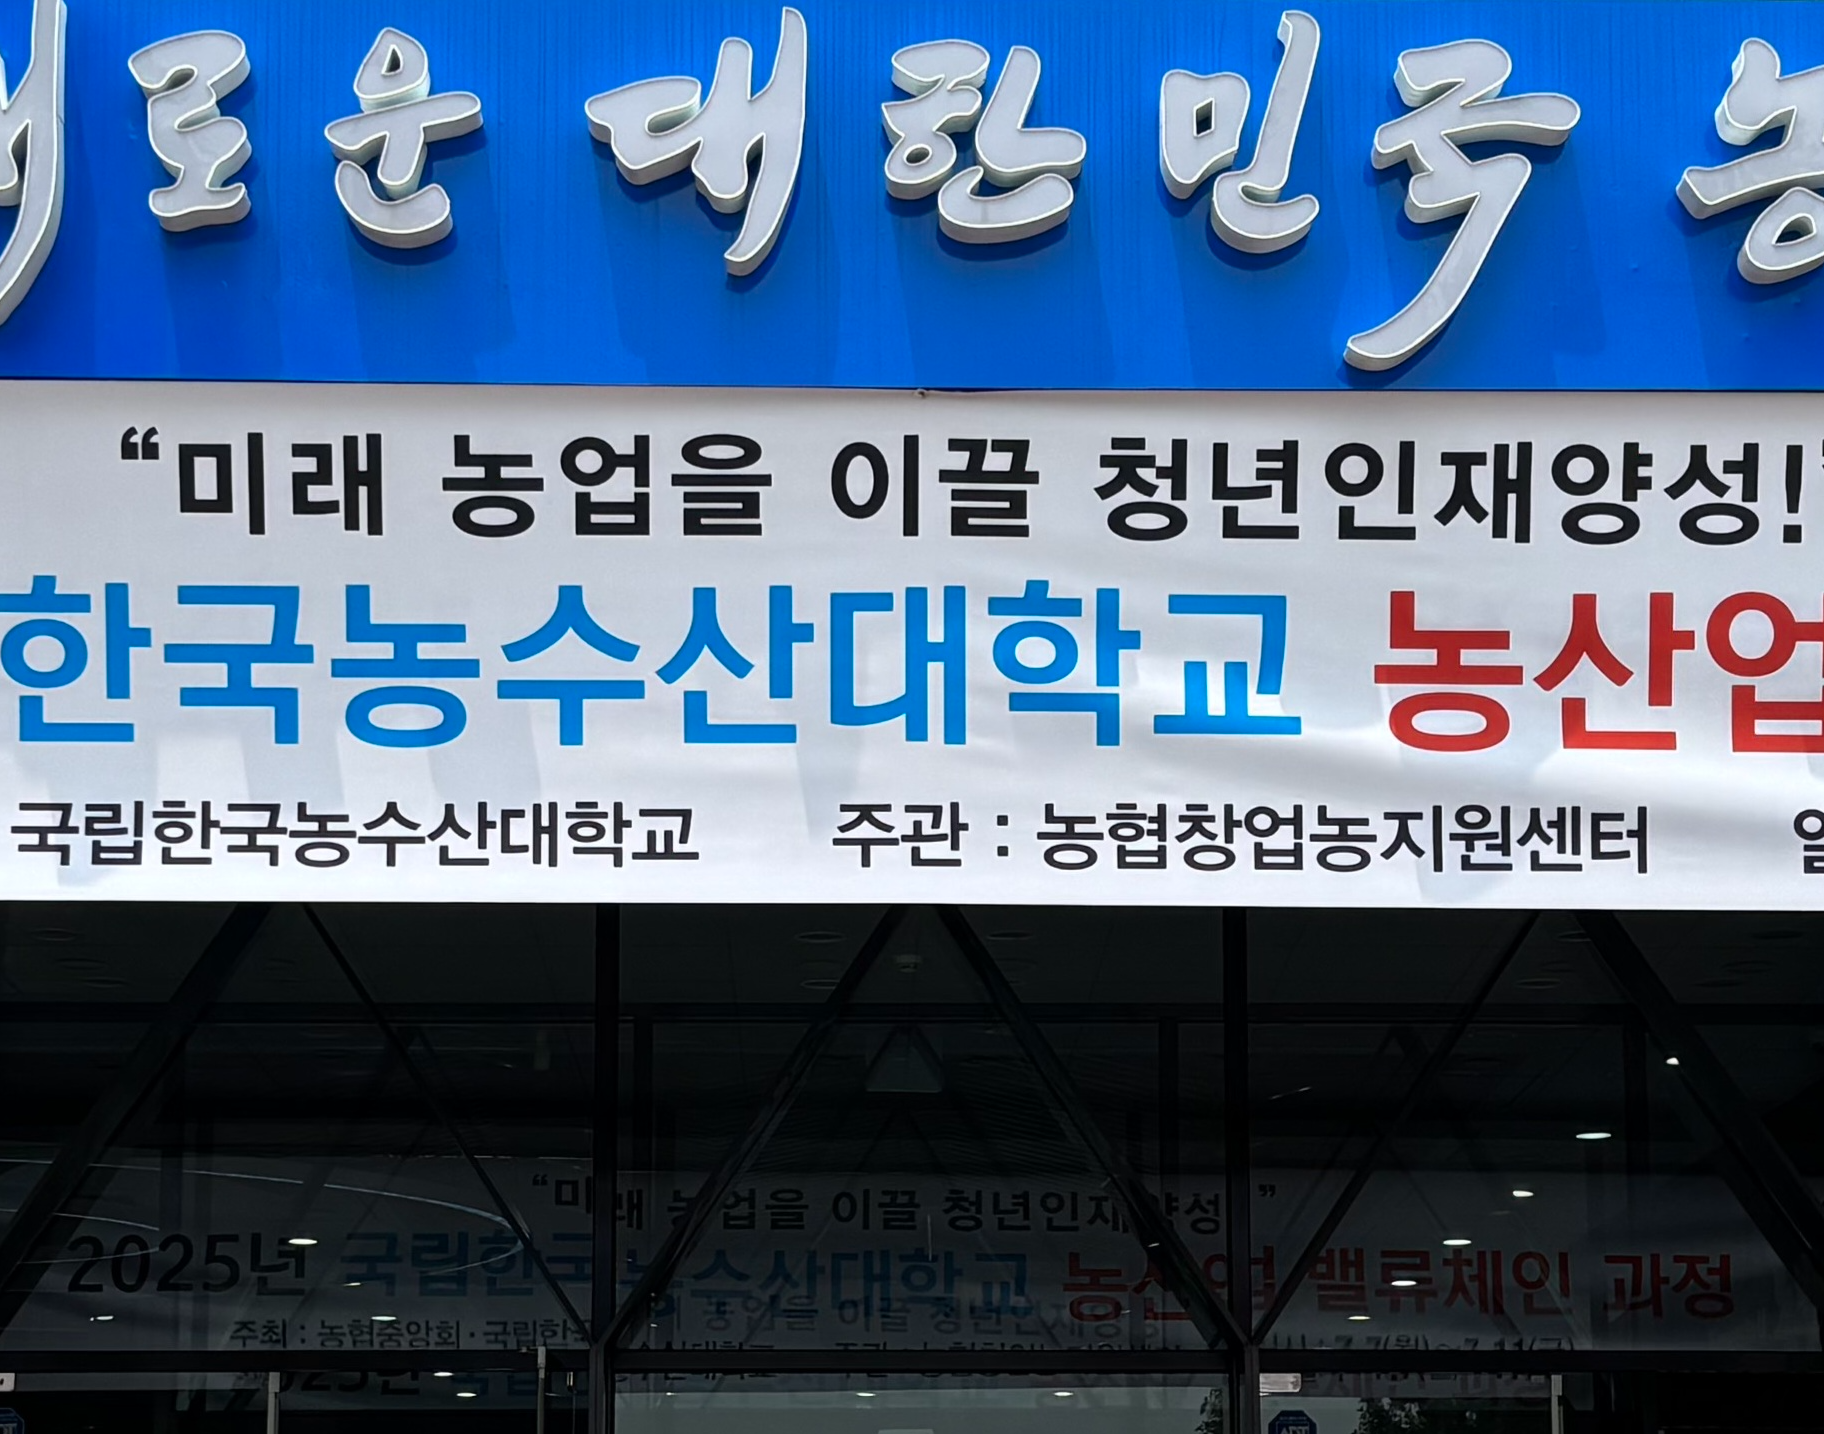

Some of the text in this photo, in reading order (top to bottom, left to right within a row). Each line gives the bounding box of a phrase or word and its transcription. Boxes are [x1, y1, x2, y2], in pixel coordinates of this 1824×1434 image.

[585, 8, 1581, 371] 대한민국
[442, 432, 773, 539] 농업을
[830, 433, 1041, 538] 이끌
[830, 801, 969, 871] 주관
[1035, 801, 1649, 876] 농협창업농지원센터
[67, 1231, 306, 1297] 2025년
[1603, 1251, 1738, 1321] 과정
